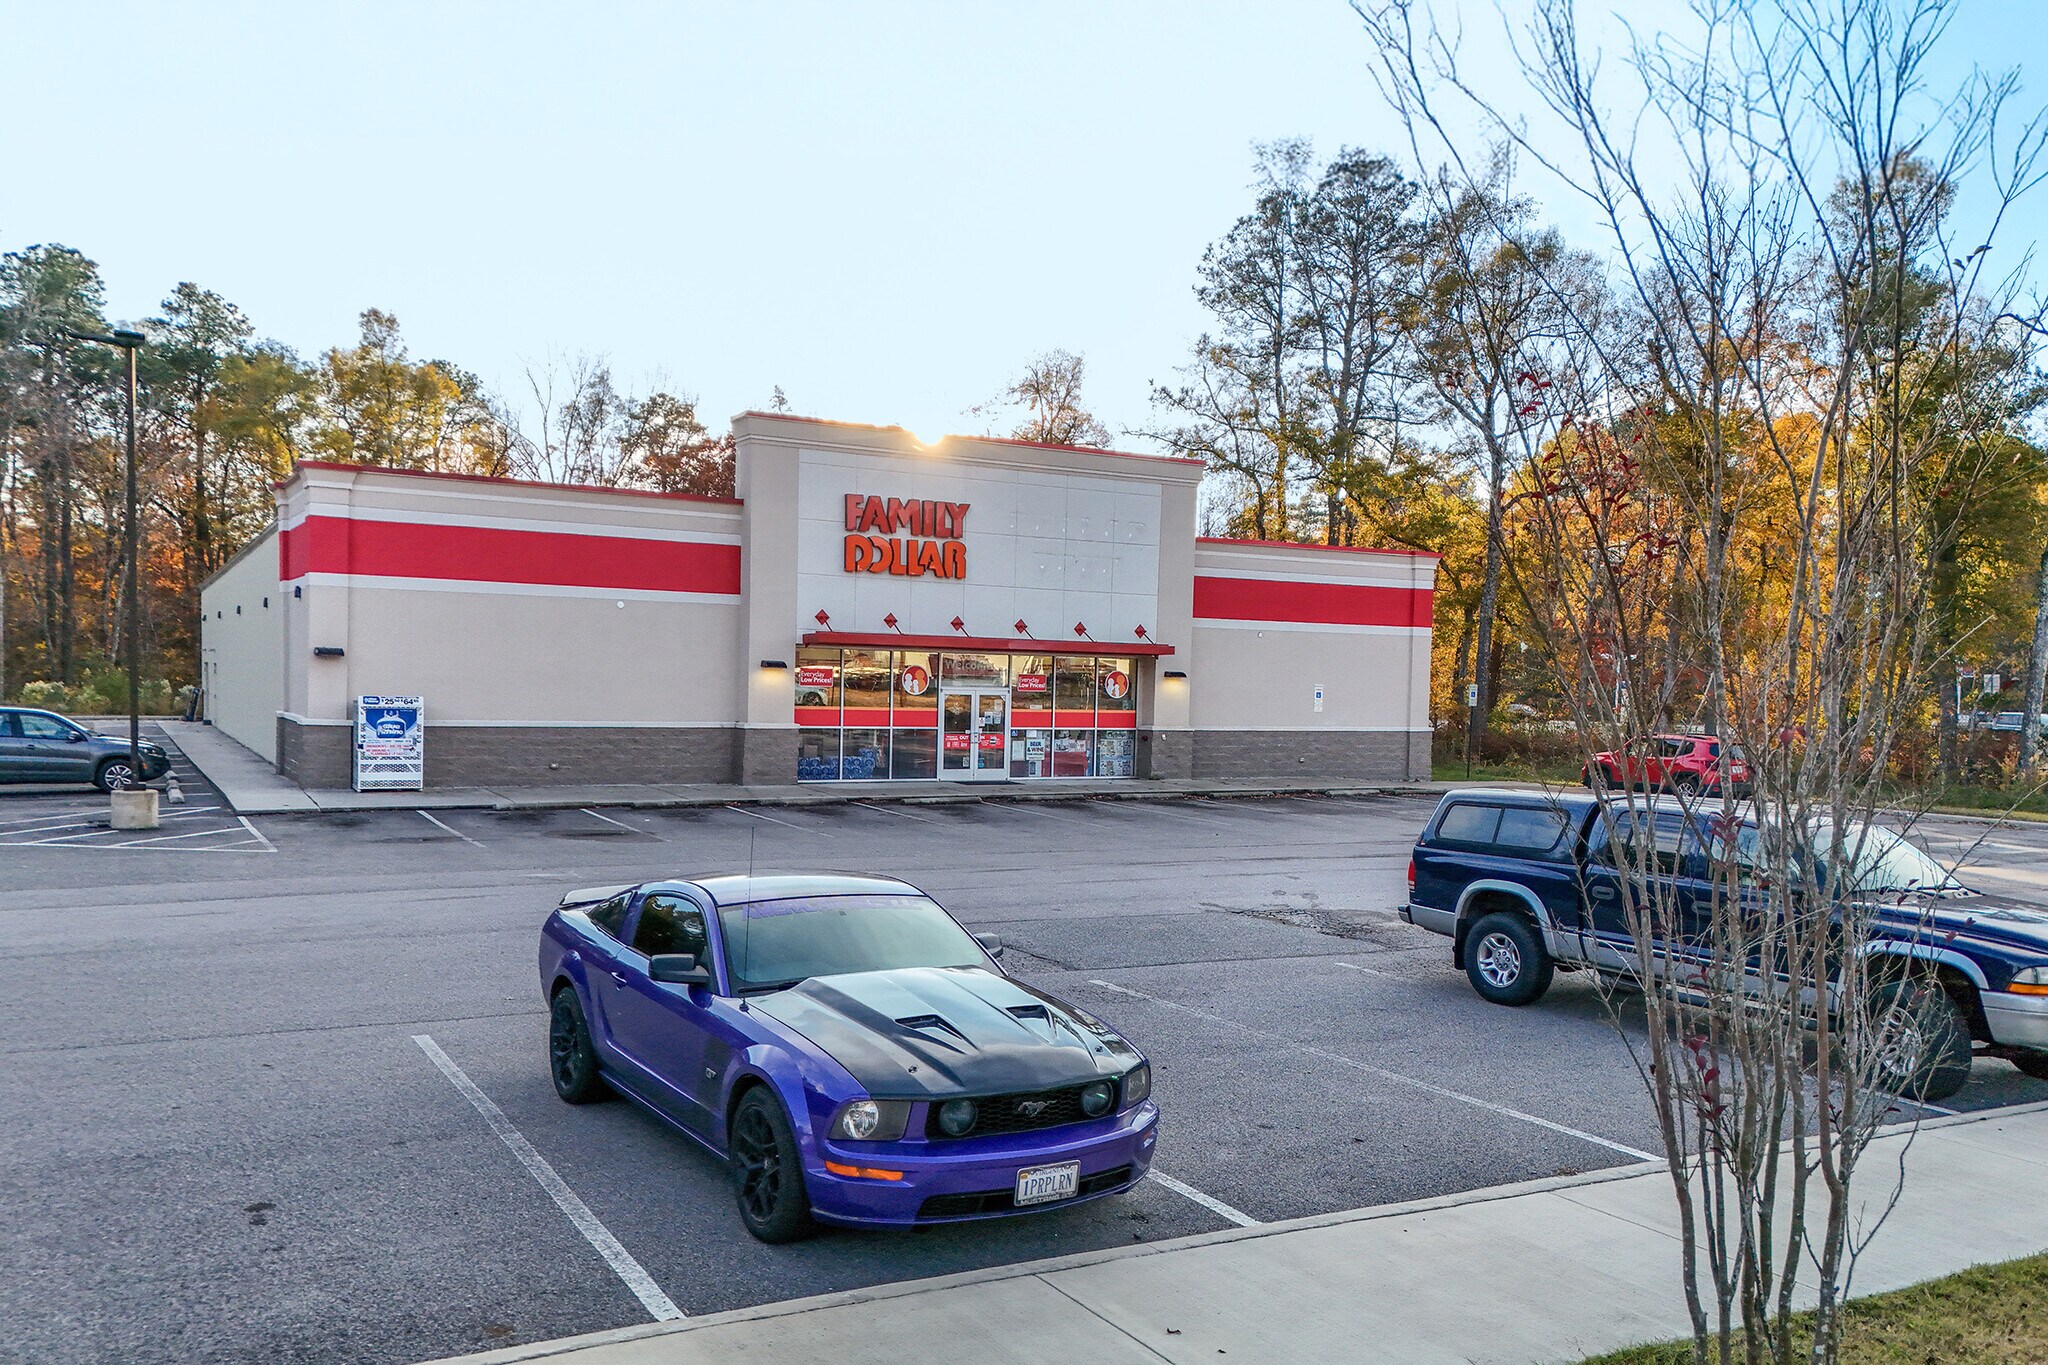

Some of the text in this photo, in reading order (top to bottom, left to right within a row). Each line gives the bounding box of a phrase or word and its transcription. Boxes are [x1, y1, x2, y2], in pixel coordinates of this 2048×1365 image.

[844, 493, 970, 539] FAMILY
[844, 534, 967, 579] DOLLAR
[801, 671, 825, 679] Everyday
[1024, 1172, 1073, 1197] 1PRPLRN
